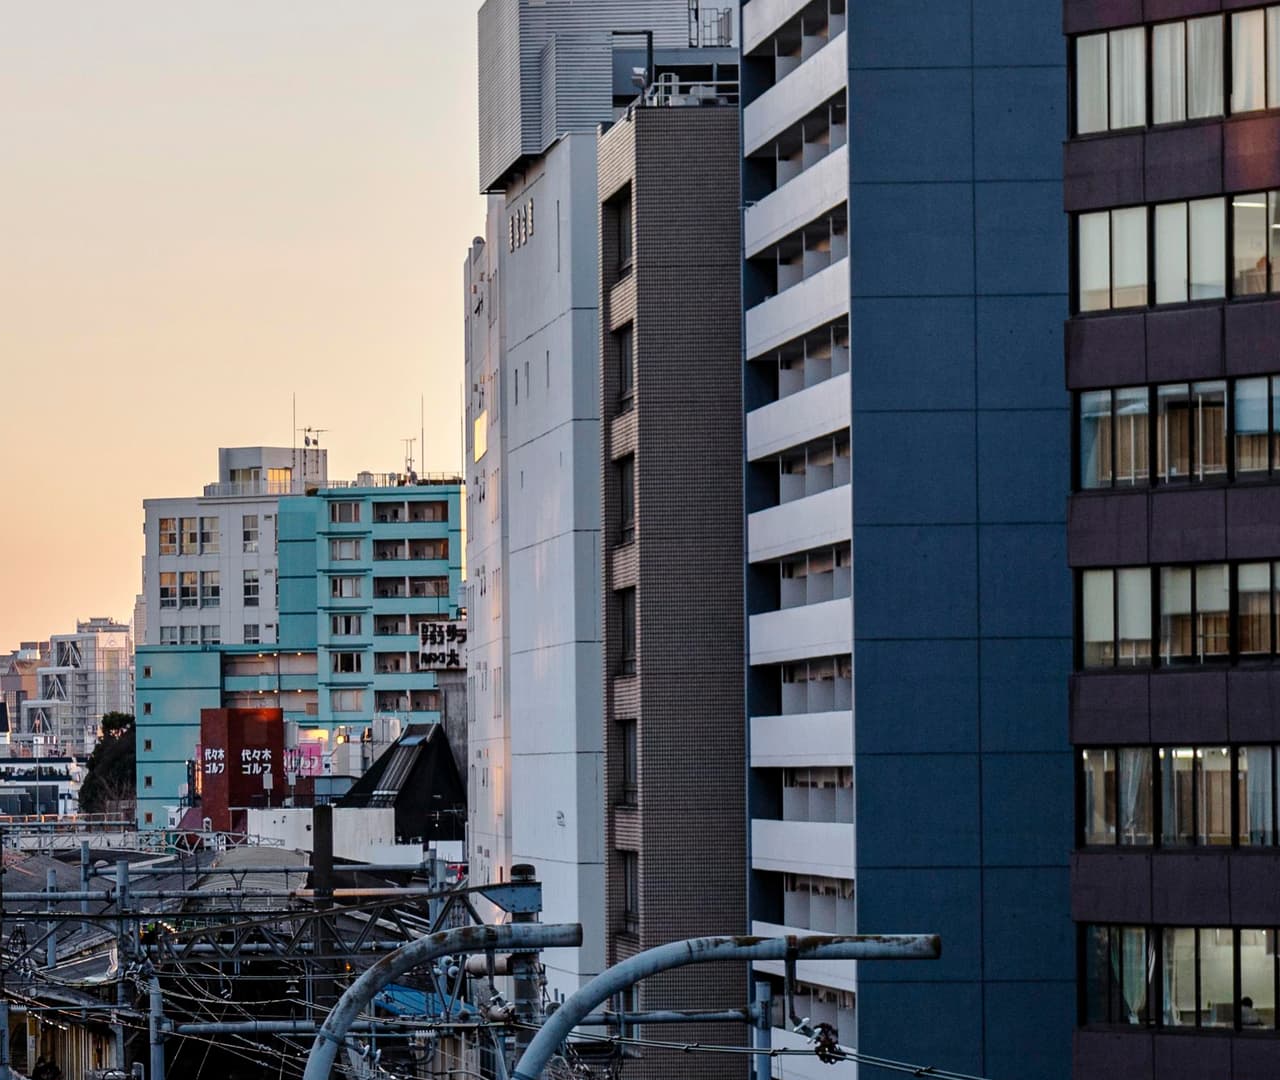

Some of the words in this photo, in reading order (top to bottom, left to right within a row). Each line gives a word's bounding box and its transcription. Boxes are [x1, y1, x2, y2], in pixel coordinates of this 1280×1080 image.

[204, 748, 225, 761] 代々木
[241, 748, 272, 762] 代々木
[204, 762, 225, 775] ゴルフ
[241, 762, 272, 775] ゴルフ
